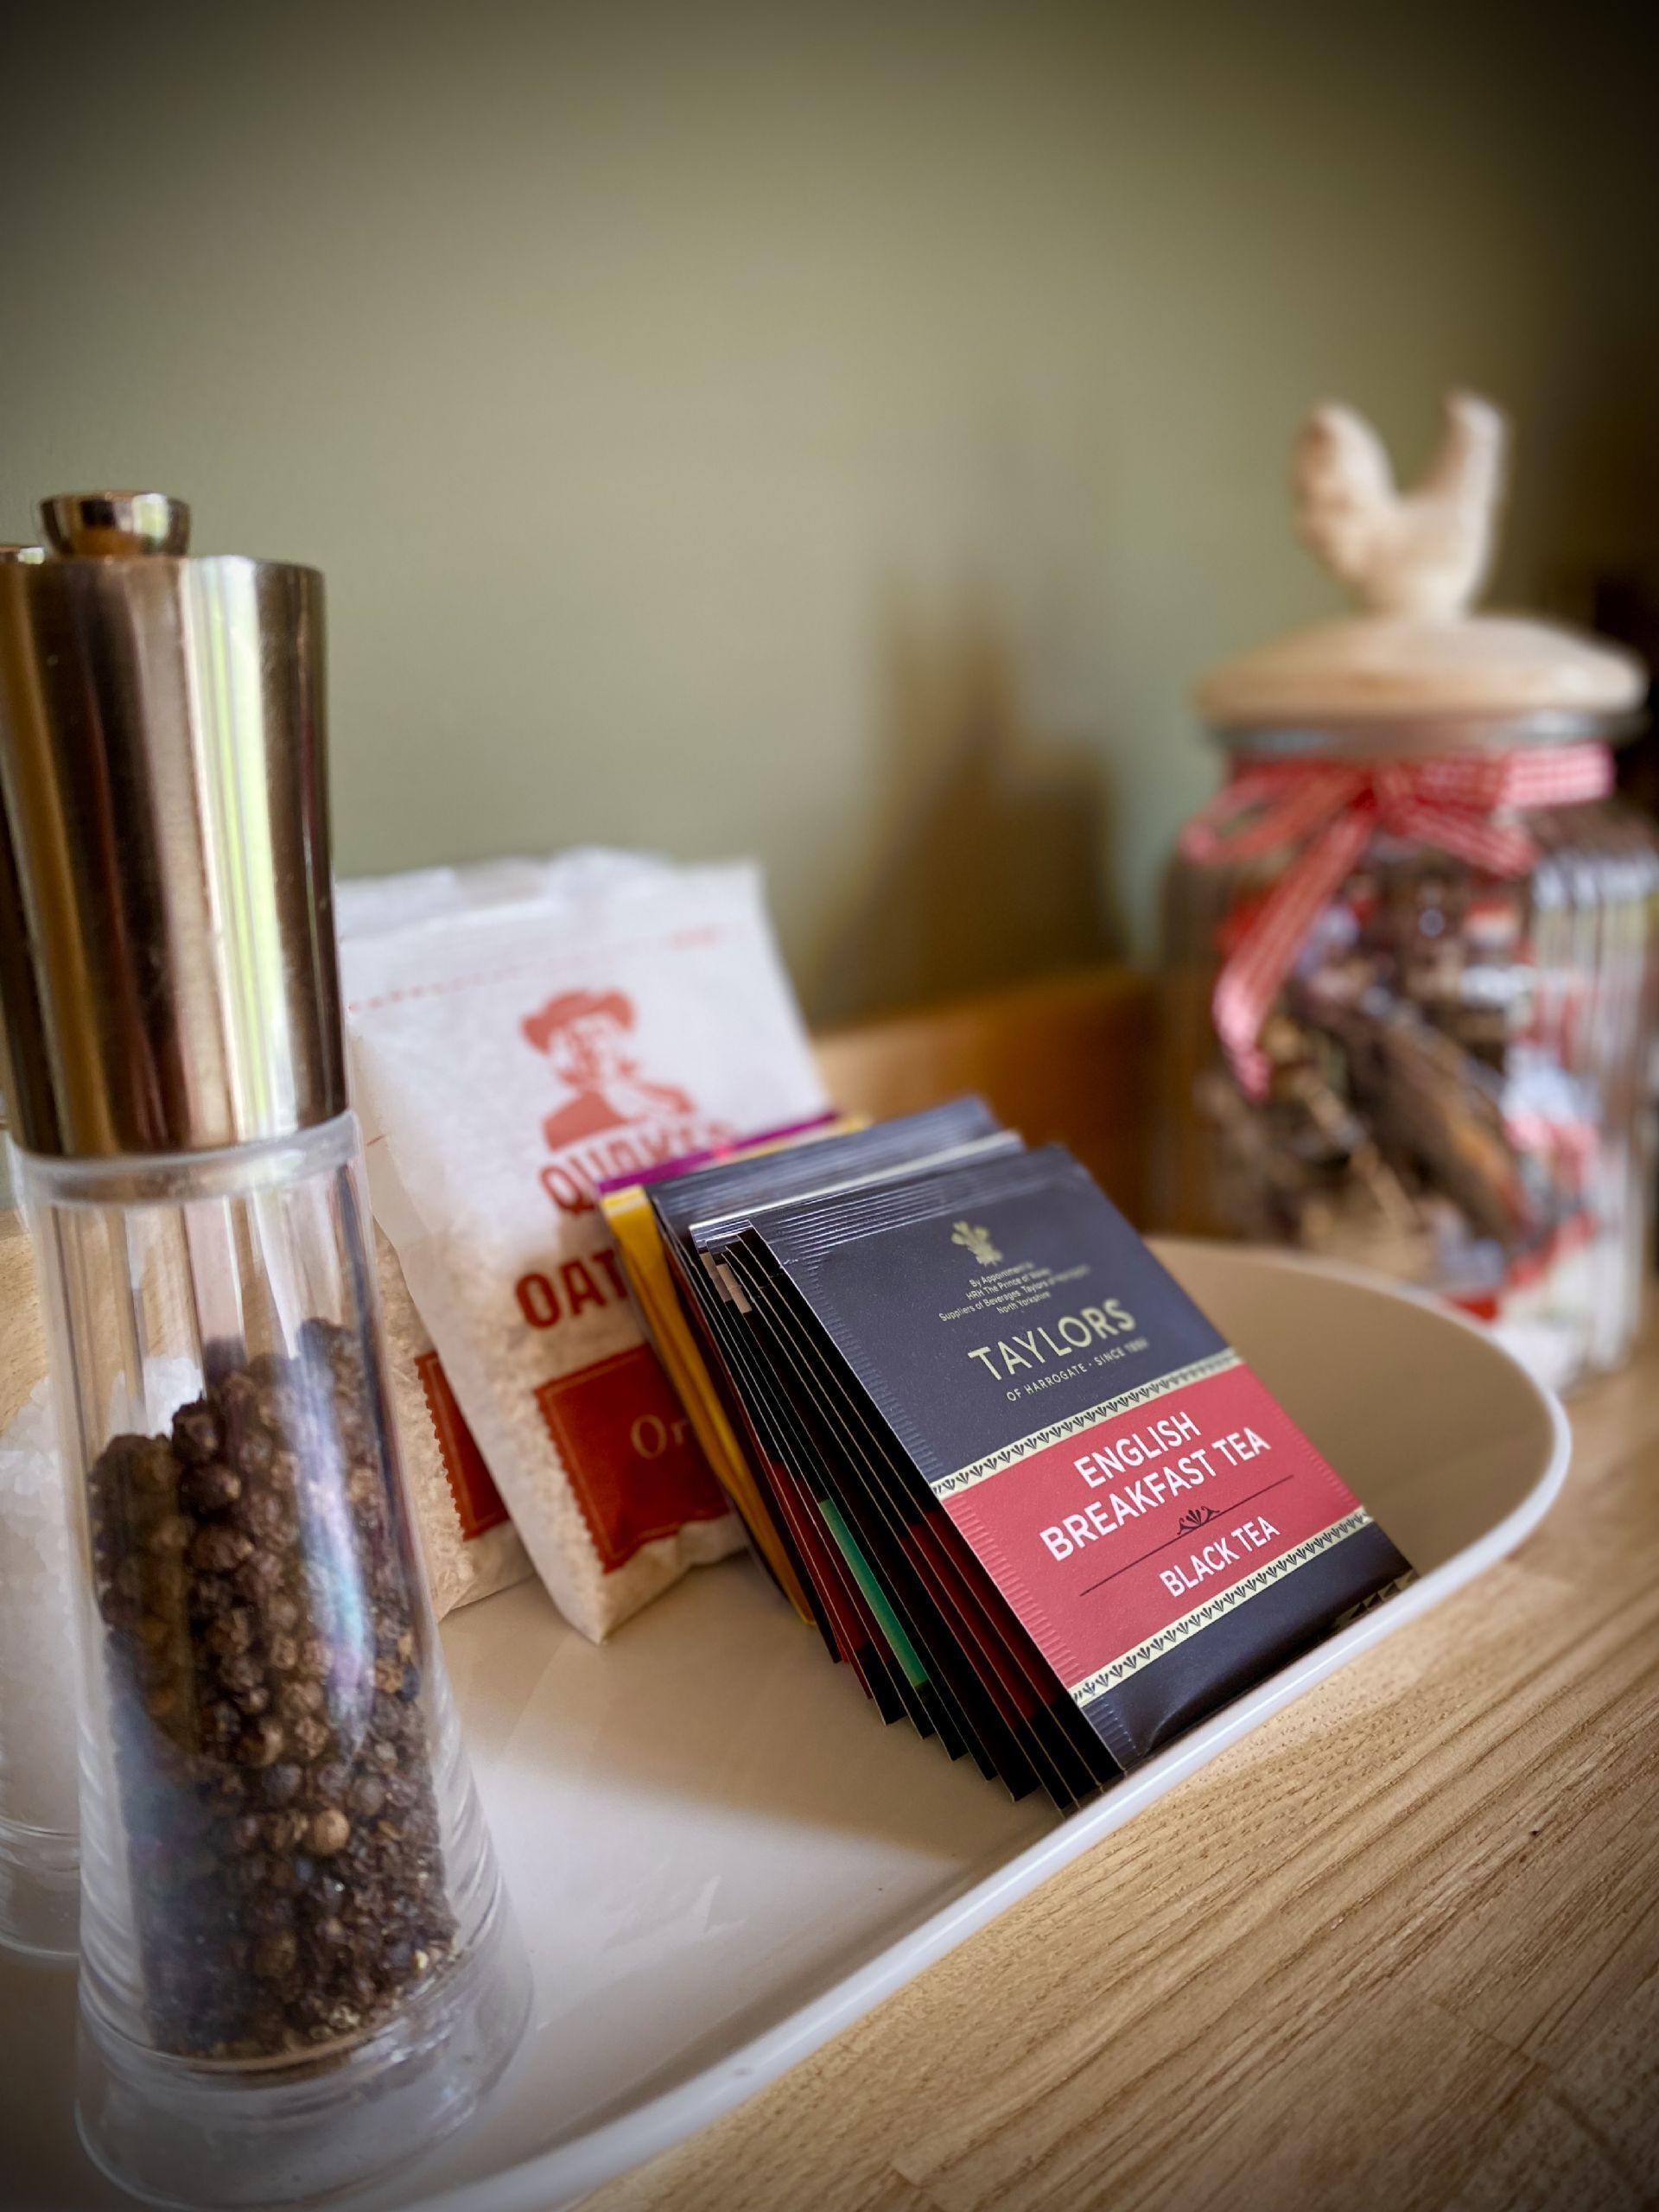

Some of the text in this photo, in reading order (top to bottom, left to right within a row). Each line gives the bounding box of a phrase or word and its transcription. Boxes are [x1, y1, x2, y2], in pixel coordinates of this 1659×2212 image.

[938, 1305, 976, 1322] Suppliers
[975, 1300, 983, 1310] of
[965, 1287, 985, 1300] HRH
[983, 1285, 998, 1297] The
[998, 1277, 1021, 1291] Prince
[969, 1278, 982, 1288] By
[996, 1302, 1018, 1314] North
[968, 1298, 1136, 1381] TAYLORS
[1007, 1388, 1021, 1402] OF
[1024, 1363, 1088, 1395] HARROGATE
[1094, 1346, 1126, 1366] SINCE
[1073, 1411, 1201, 1489] ENGLISH
[1039, 1427, 1272, 1561] BREAKFAST TEA
[1159, 1516, 1281, 1598] BLACK TEA
